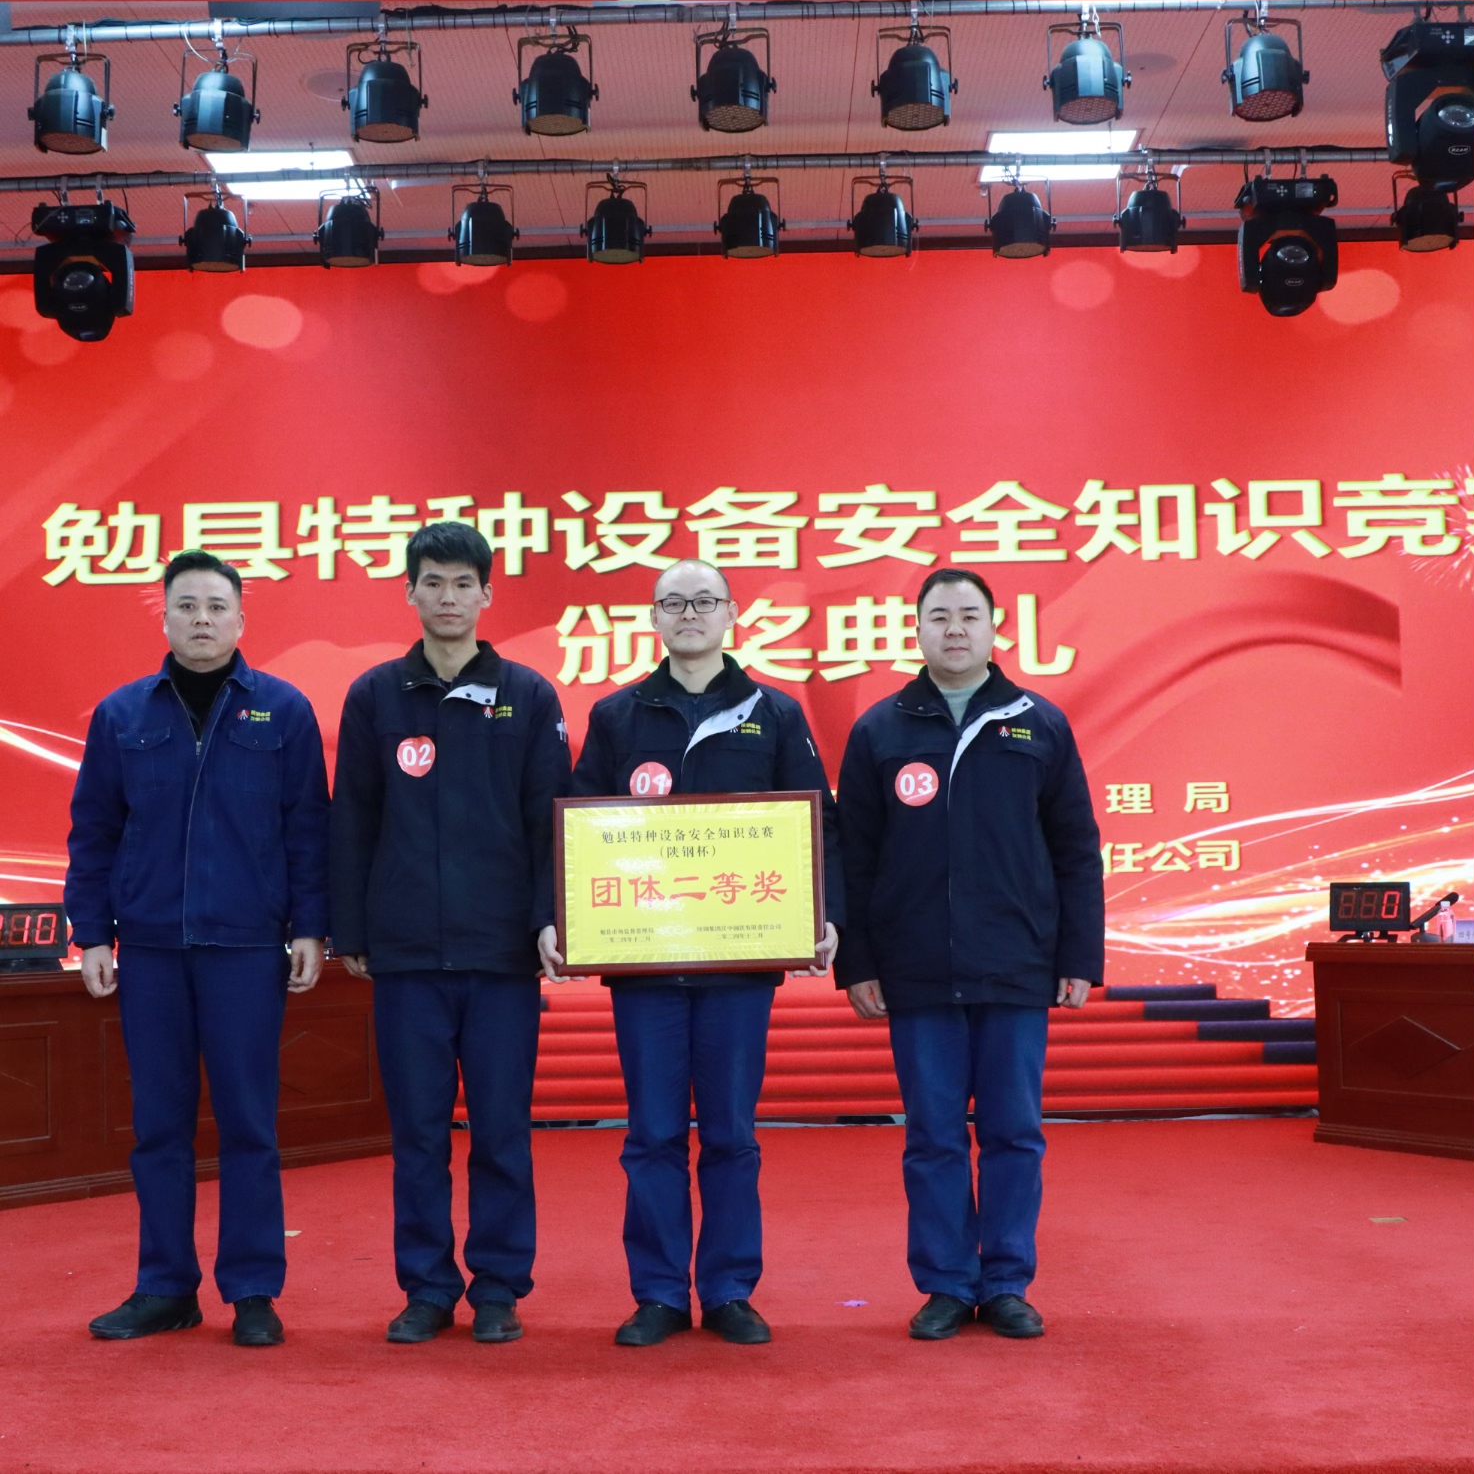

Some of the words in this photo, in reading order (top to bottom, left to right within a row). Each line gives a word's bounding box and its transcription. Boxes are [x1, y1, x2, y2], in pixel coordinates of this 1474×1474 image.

[42, 473, 1474, 587] 勉县特种设备安全知识竞
[402, 744, 432, 766] 02
[900, 773, 933, 796] 03
[602, 826, 774, 844] 勉县特种设备安全知识竞赛
[659, 845, 716, 859] （陕钢杯）
[1101, 839, 1242, 874] 任公司
[591, 870, 788, 909] 团体二等奖
[0, 913, 57, 944] 10
